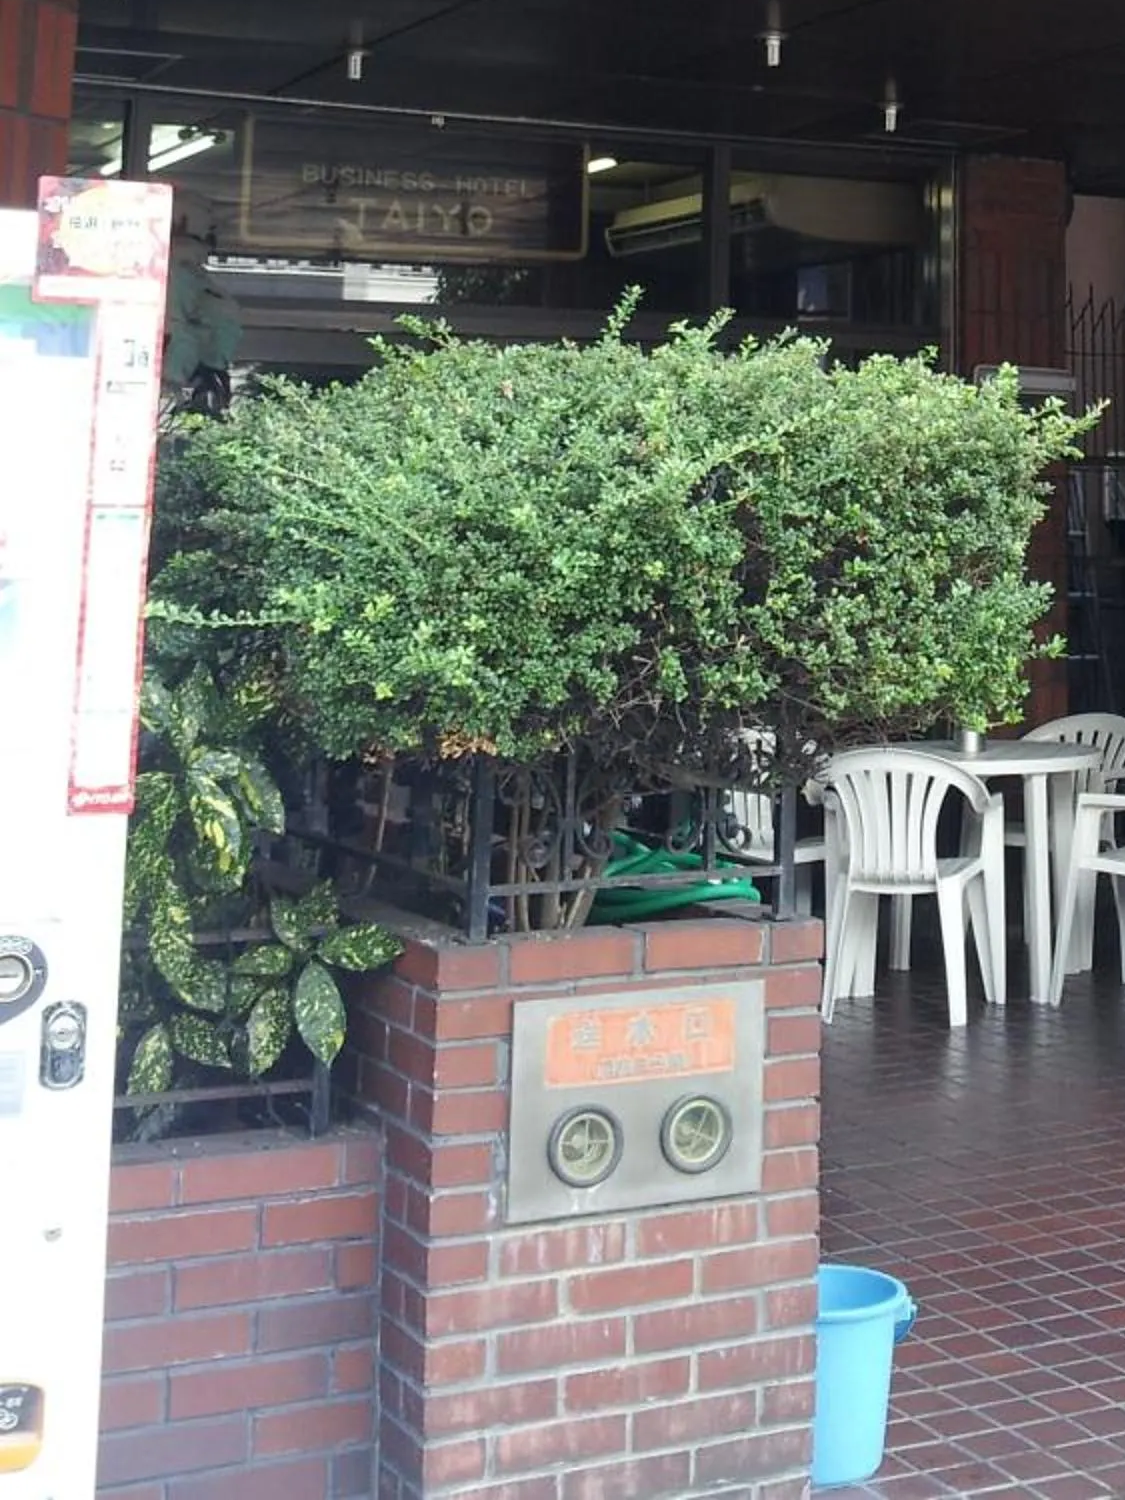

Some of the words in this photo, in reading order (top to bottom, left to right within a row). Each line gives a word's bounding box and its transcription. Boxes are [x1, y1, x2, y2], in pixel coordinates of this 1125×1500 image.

[302, 163, 437, 190] BUSINESS
[456, 175, 530, 199] HOTEL
[348, 197, 494, 236] TAIYO
